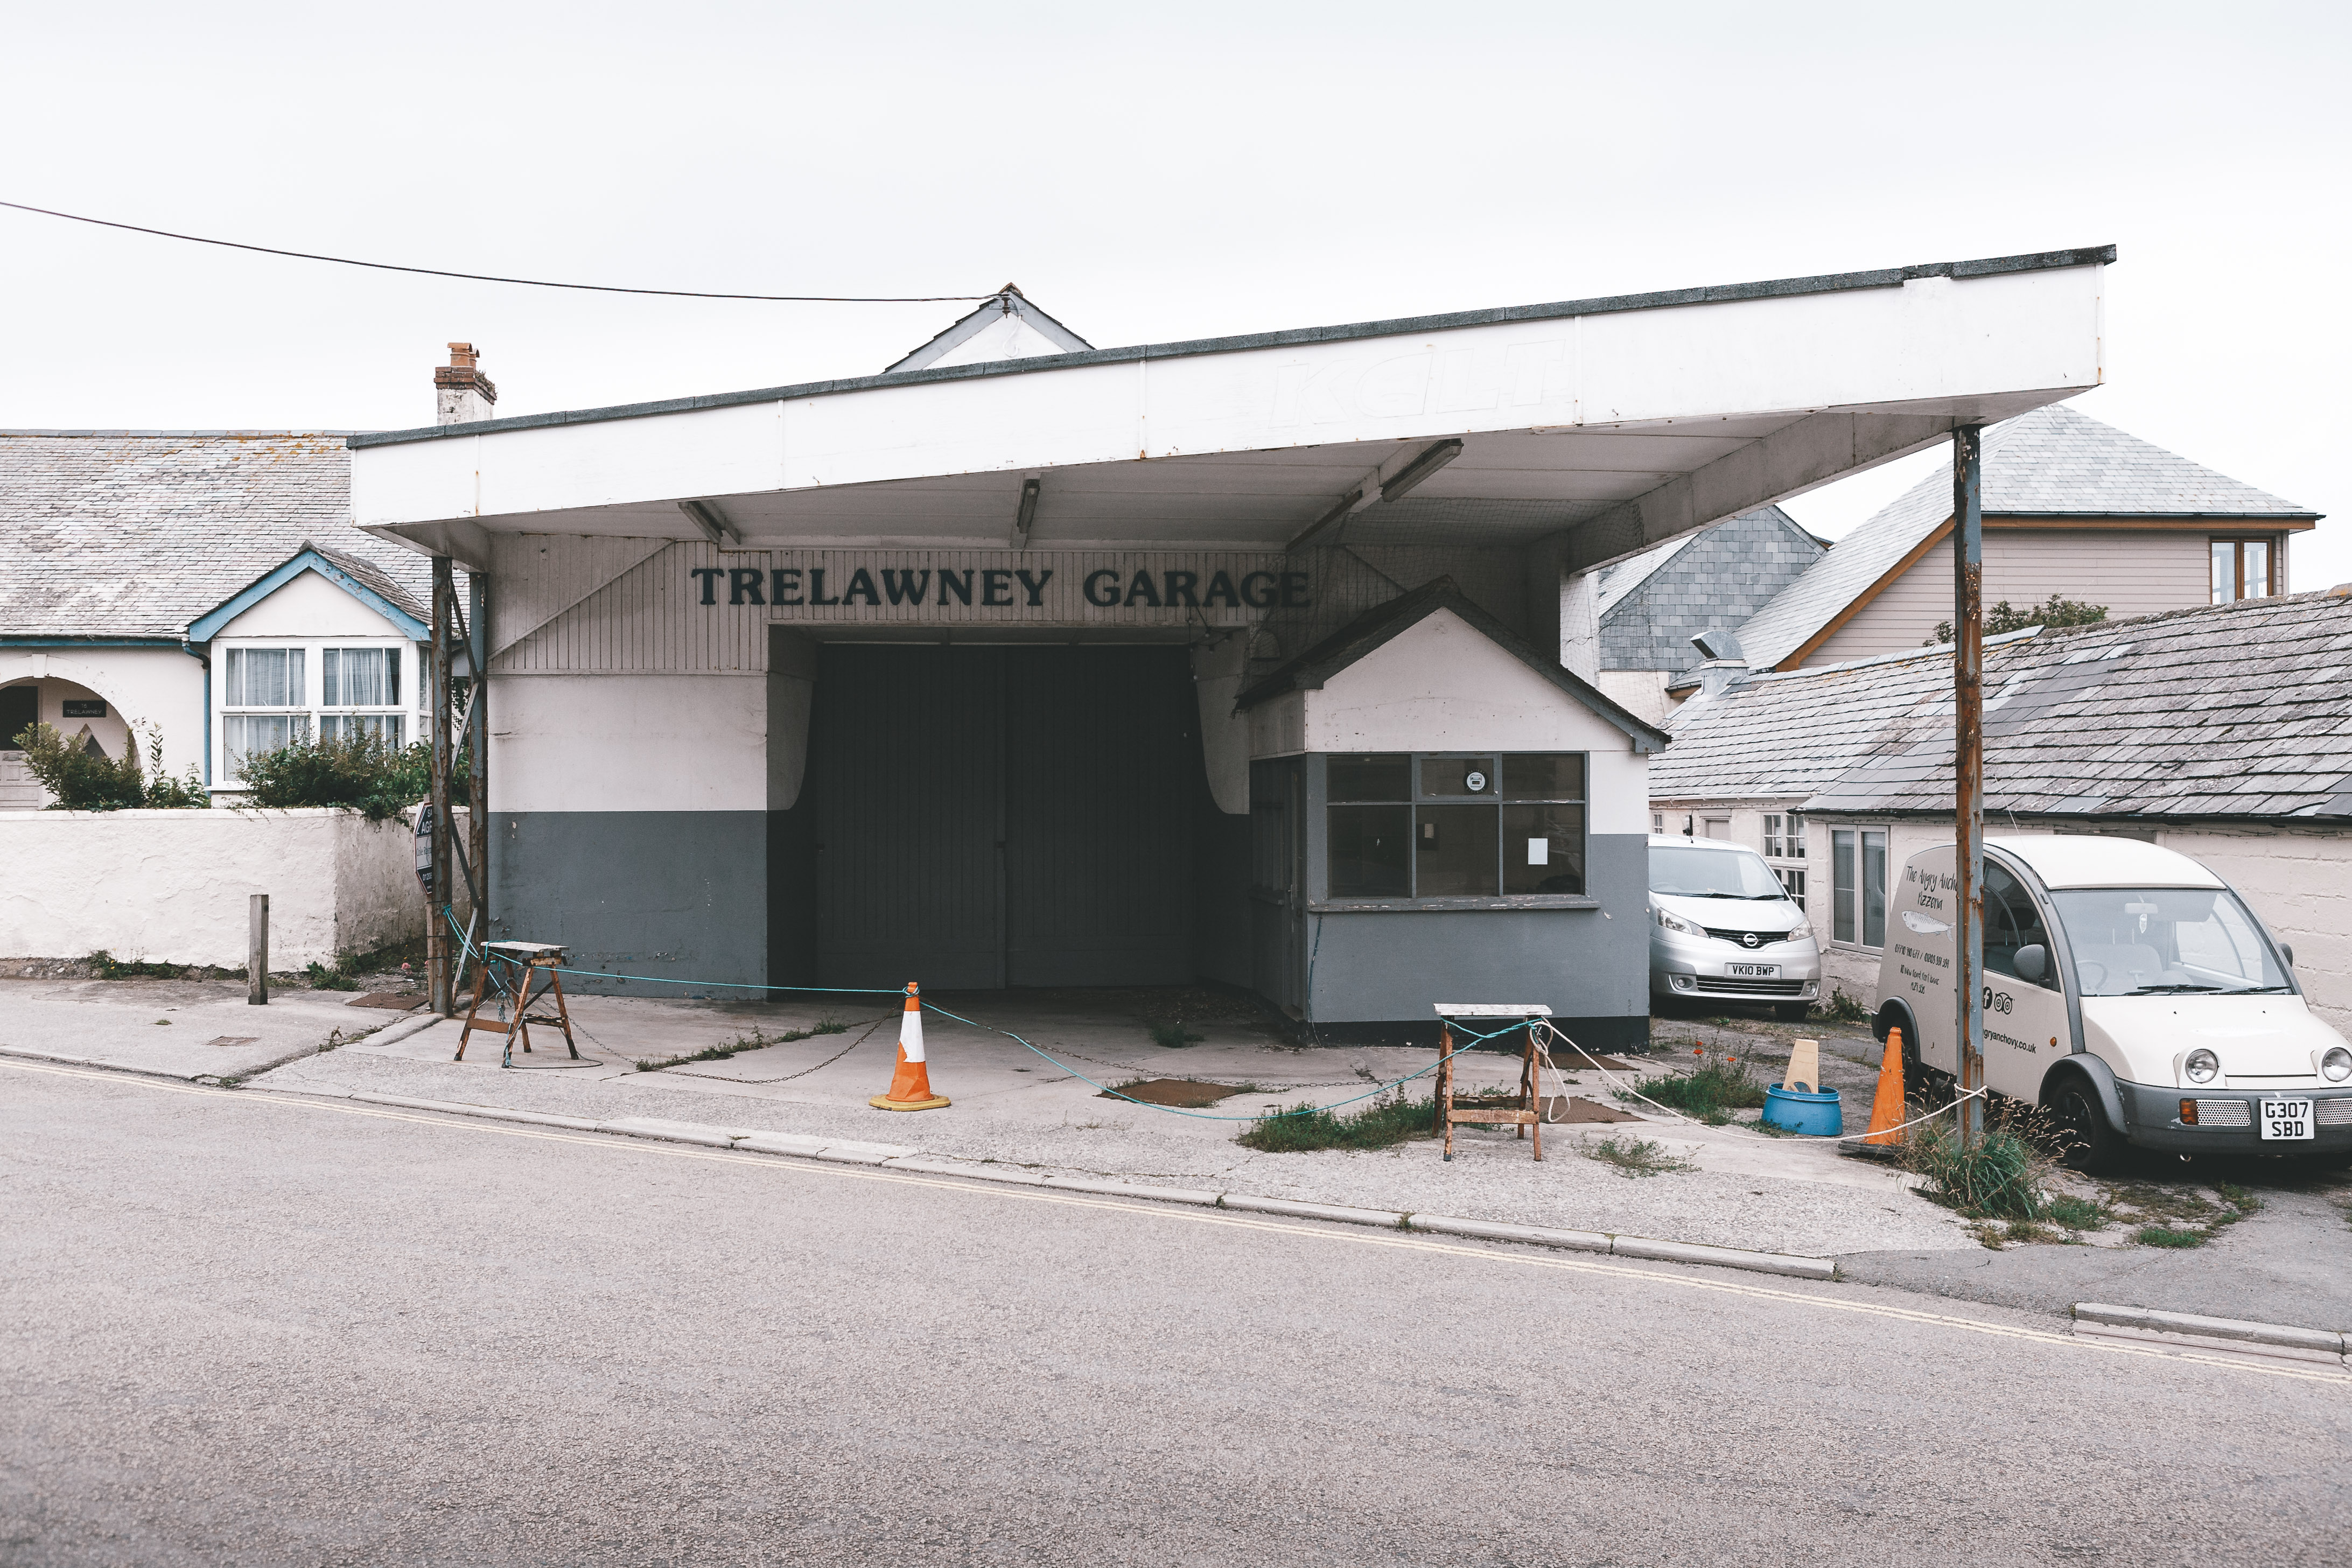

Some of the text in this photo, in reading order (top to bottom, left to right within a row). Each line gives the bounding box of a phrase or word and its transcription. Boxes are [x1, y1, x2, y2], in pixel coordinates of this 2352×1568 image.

[691, 568, 1312, 607] TRELAWNEY GARAGE
[1907, 865, 1917, 883] The
[1918, 869, 1937, 892] Angry
[1917, 891, 1943, 911] Pizzeria
[1732, 965, 1774, 976] VK10 BWP
[2265, 1102, 2308, 1118] G307
[2272, 1121, 2304, 1137] SBD
